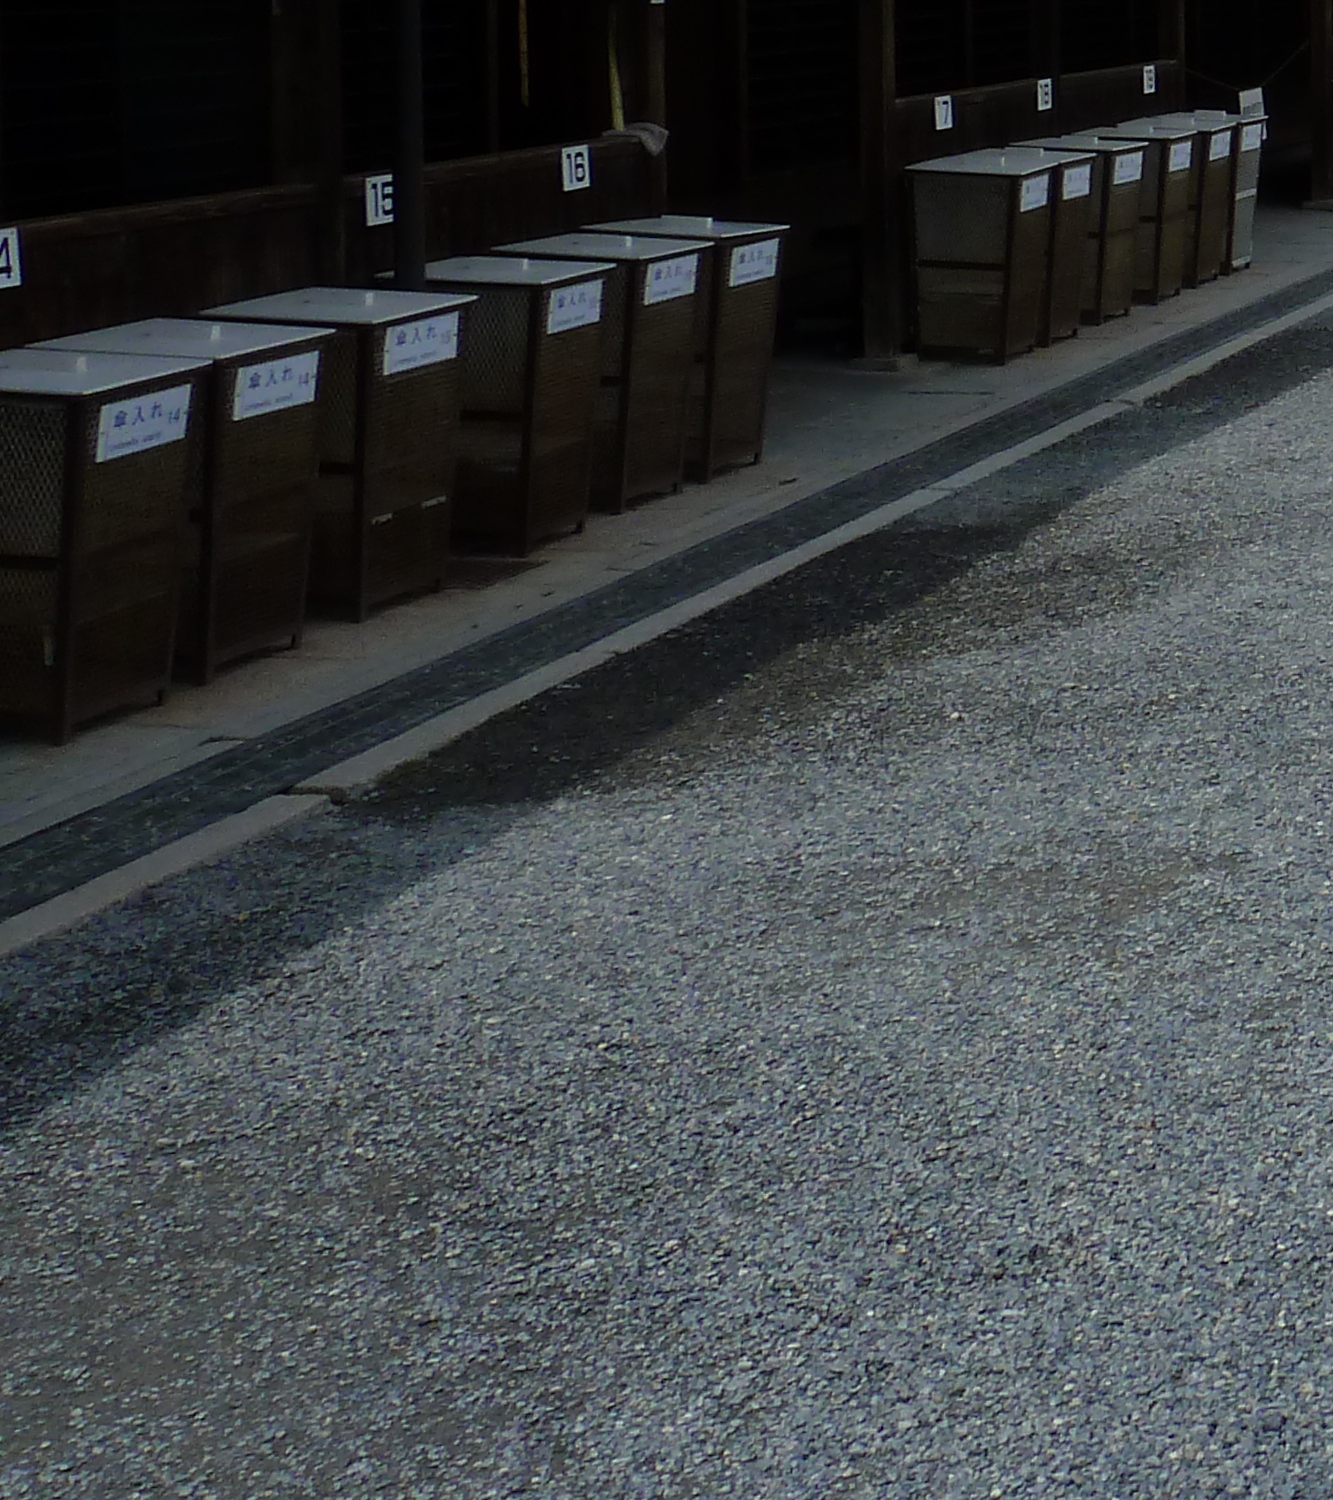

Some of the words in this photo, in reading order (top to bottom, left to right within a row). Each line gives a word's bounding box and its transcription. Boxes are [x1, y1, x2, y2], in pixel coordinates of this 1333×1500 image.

[566, 151, 585, 184] 16
[247, 366, 293, 390] 傘入れ
[113, 402, 163, 428] 傘入れ
